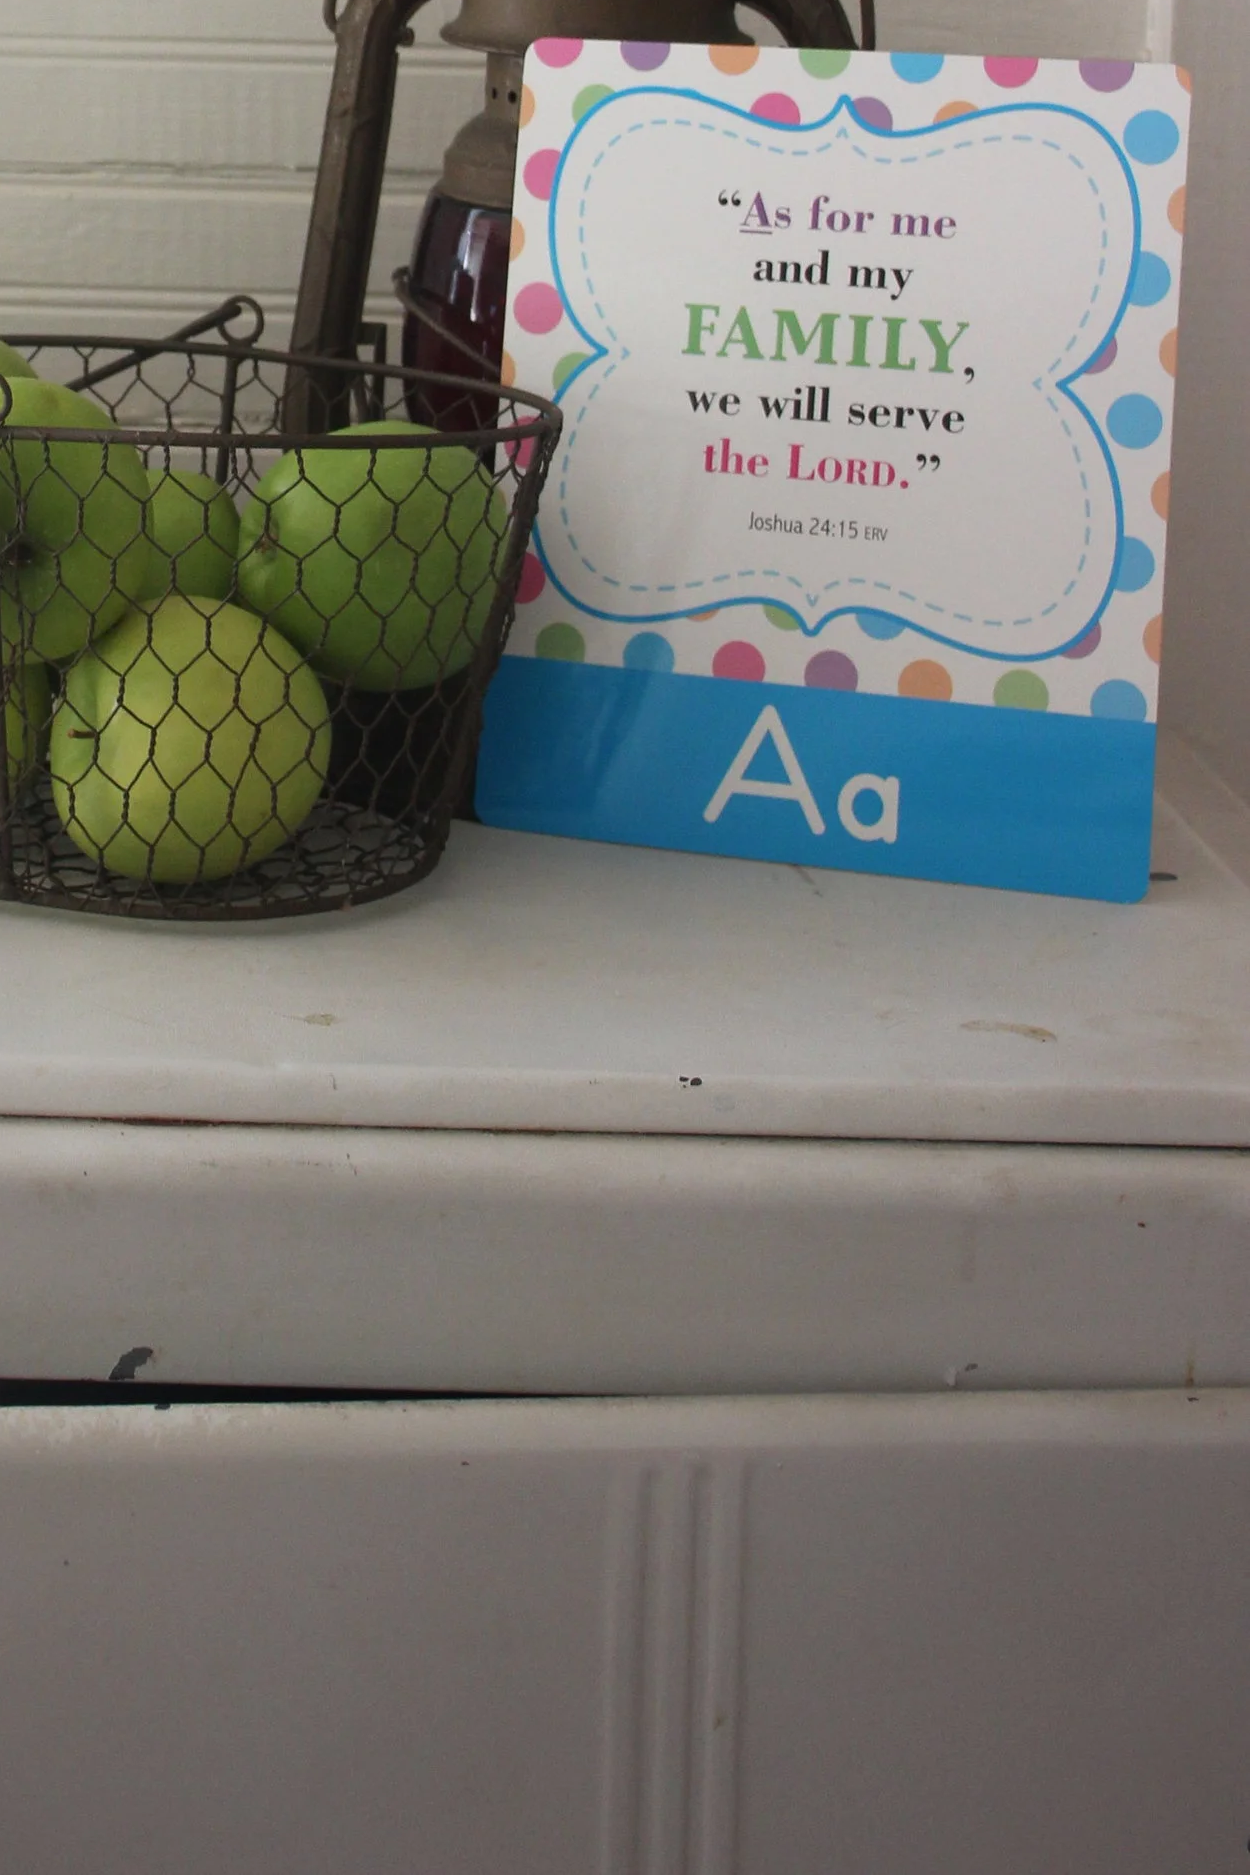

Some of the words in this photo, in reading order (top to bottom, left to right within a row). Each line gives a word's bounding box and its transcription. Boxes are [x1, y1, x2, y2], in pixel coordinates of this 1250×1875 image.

[718, 189, 791, 234] “As
[808, 195, 874, 233] for
[890, 213, 956, 239] me
[753, 249, 830, 285] and
[847, 265, 914, 300] my
[681, 303, 975, 385] FAMILY,
[686, 390, 741, 416] we
[759, 385, 830, 423] will
[848, 402, 965, 433] serve
[703, 437, 769, 477] the
[748, 511, 803, 535] Joshua
[809, 517, 858, 539] 24:15
[864, 526, 888, 541] ERV
[703, 704, 899, 844] Aa
